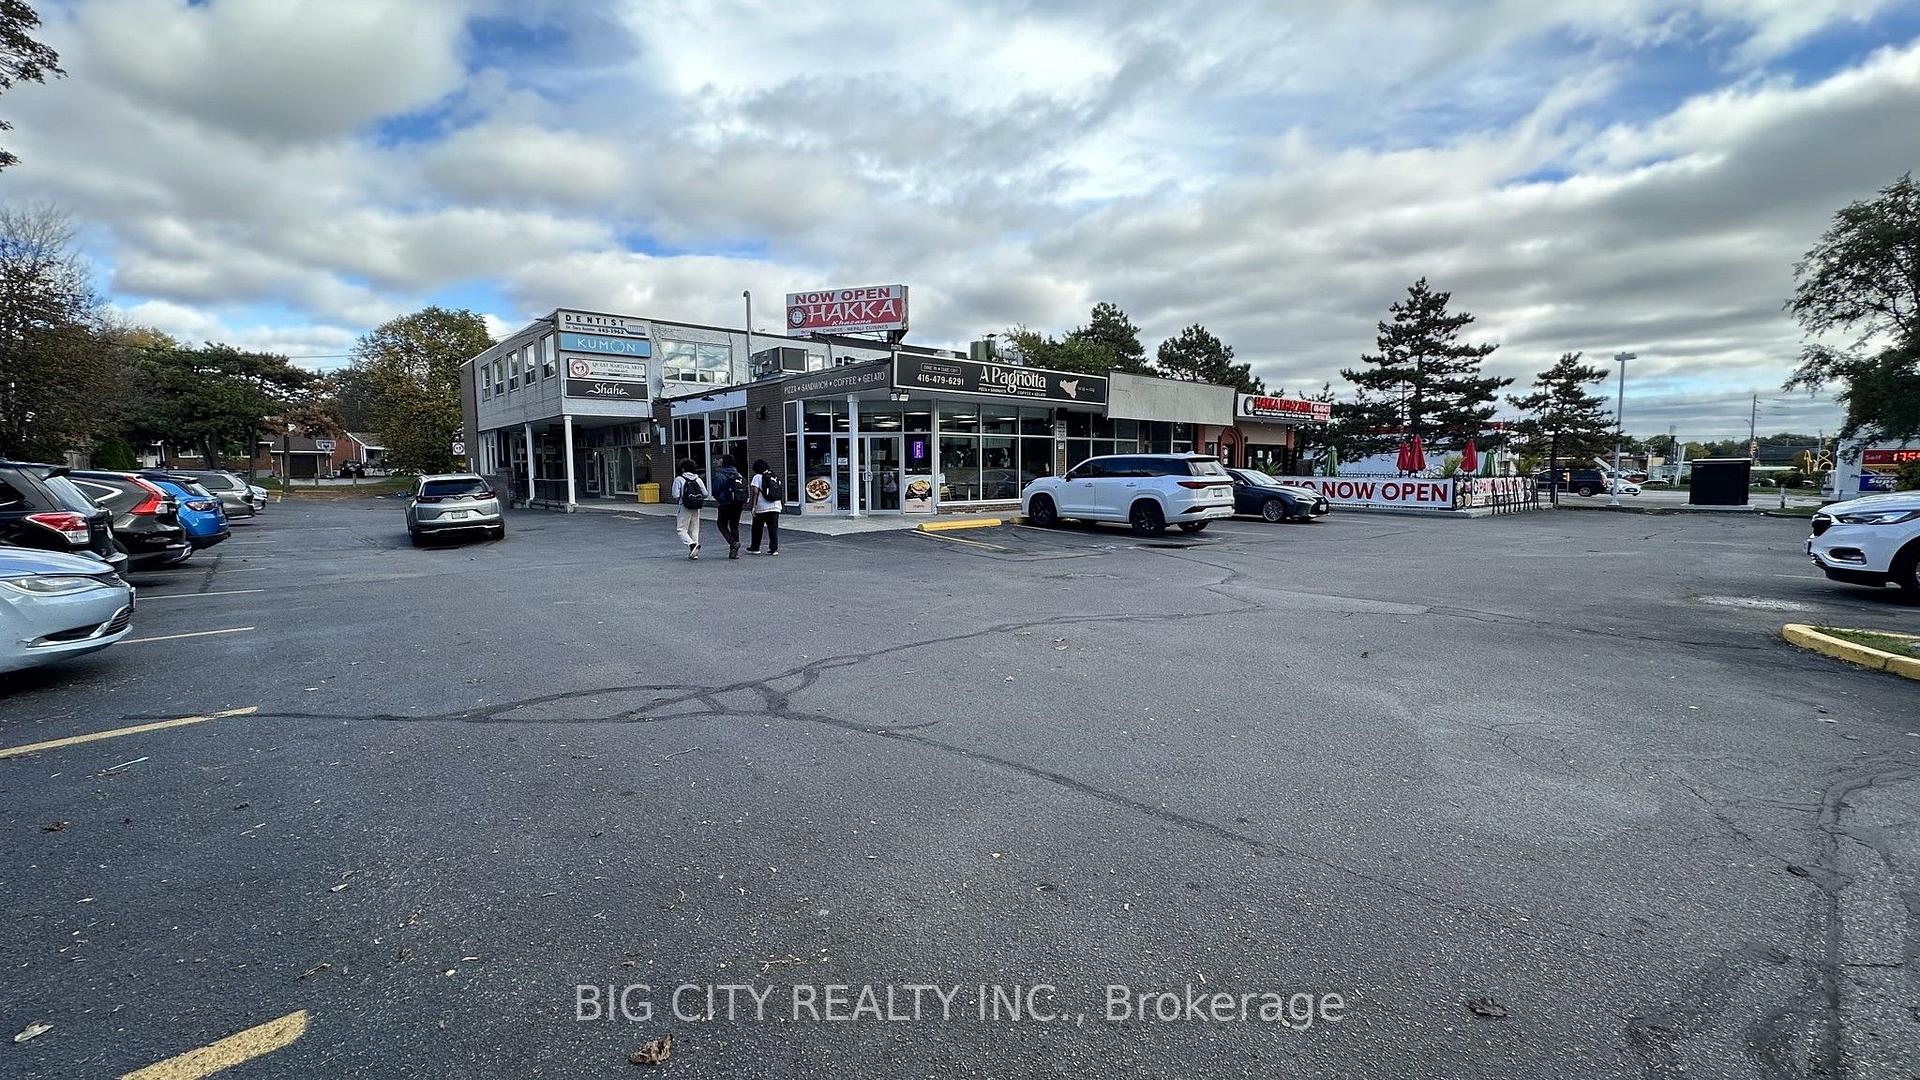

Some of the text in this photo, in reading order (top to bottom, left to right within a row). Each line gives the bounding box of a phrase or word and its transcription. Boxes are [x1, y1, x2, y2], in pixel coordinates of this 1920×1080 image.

[795, 288, 891, 304] NOW OPEN
[809, 299, 897, 323] HAKKA
[565, 314, 625, 327] DENTIST
[577, 338, 636, 353] KUMON
[784, 371, 886, 394] PIZZA SANDWICH COFFEE GELATO
[917, 373, 964, 387] 416-479-6291
[979, 366, 1046, 394] A Pagnotta
[1322, 481, 1376, 500] NOW
[1381, 482, 1448, 502] OPEN
